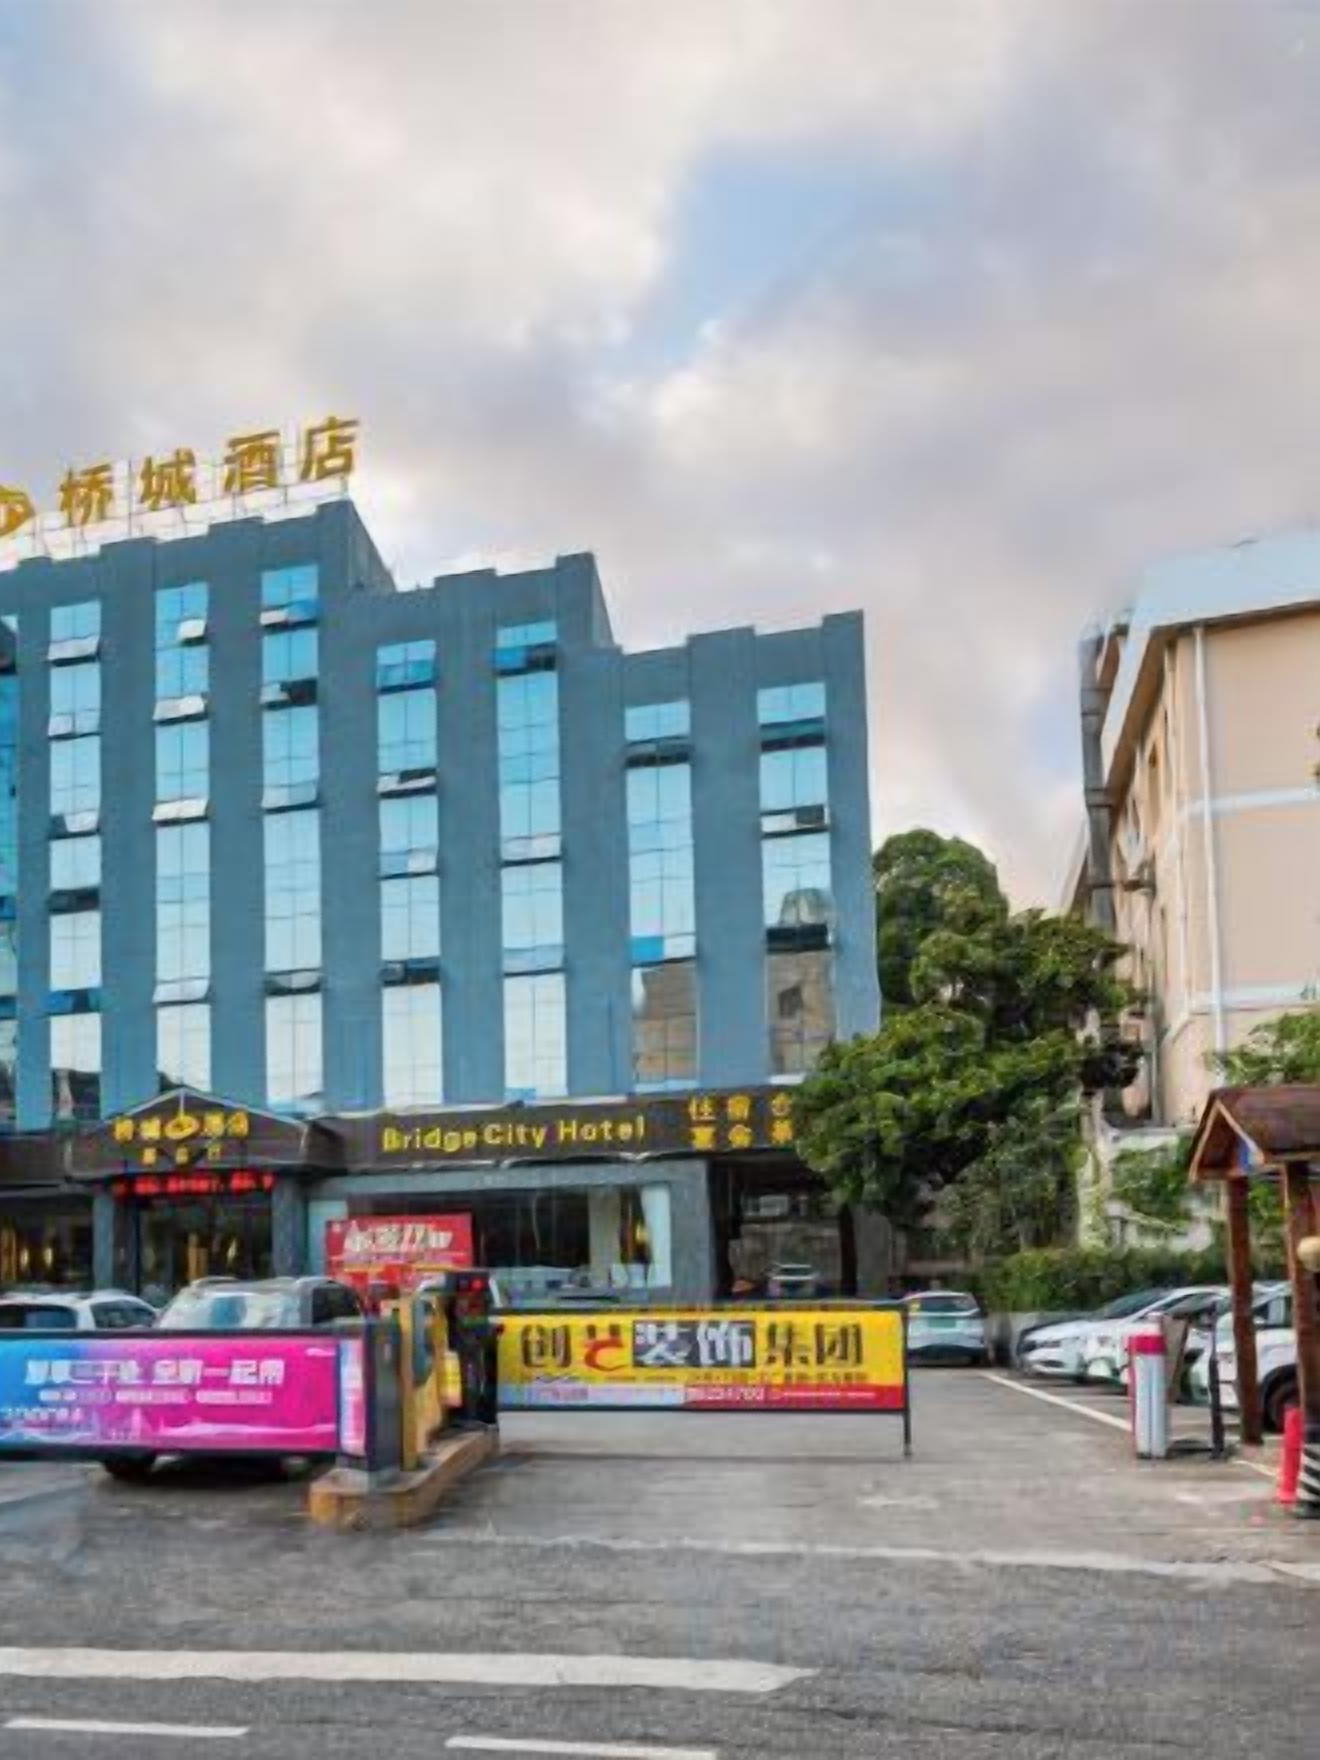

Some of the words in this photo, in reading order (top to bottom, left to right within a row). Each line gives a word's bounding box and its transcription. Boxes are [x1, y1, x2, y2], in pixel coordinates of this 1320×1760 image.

[59, 415, 360, 526] 桥城酒店
[382, 1127, 477, 1153] Bridge
[483, 1122, 547, 1149] City
[558, 1115, 645, 1145] Hotel
[521, 1319, 863, 1372] 创艺装饰集团
